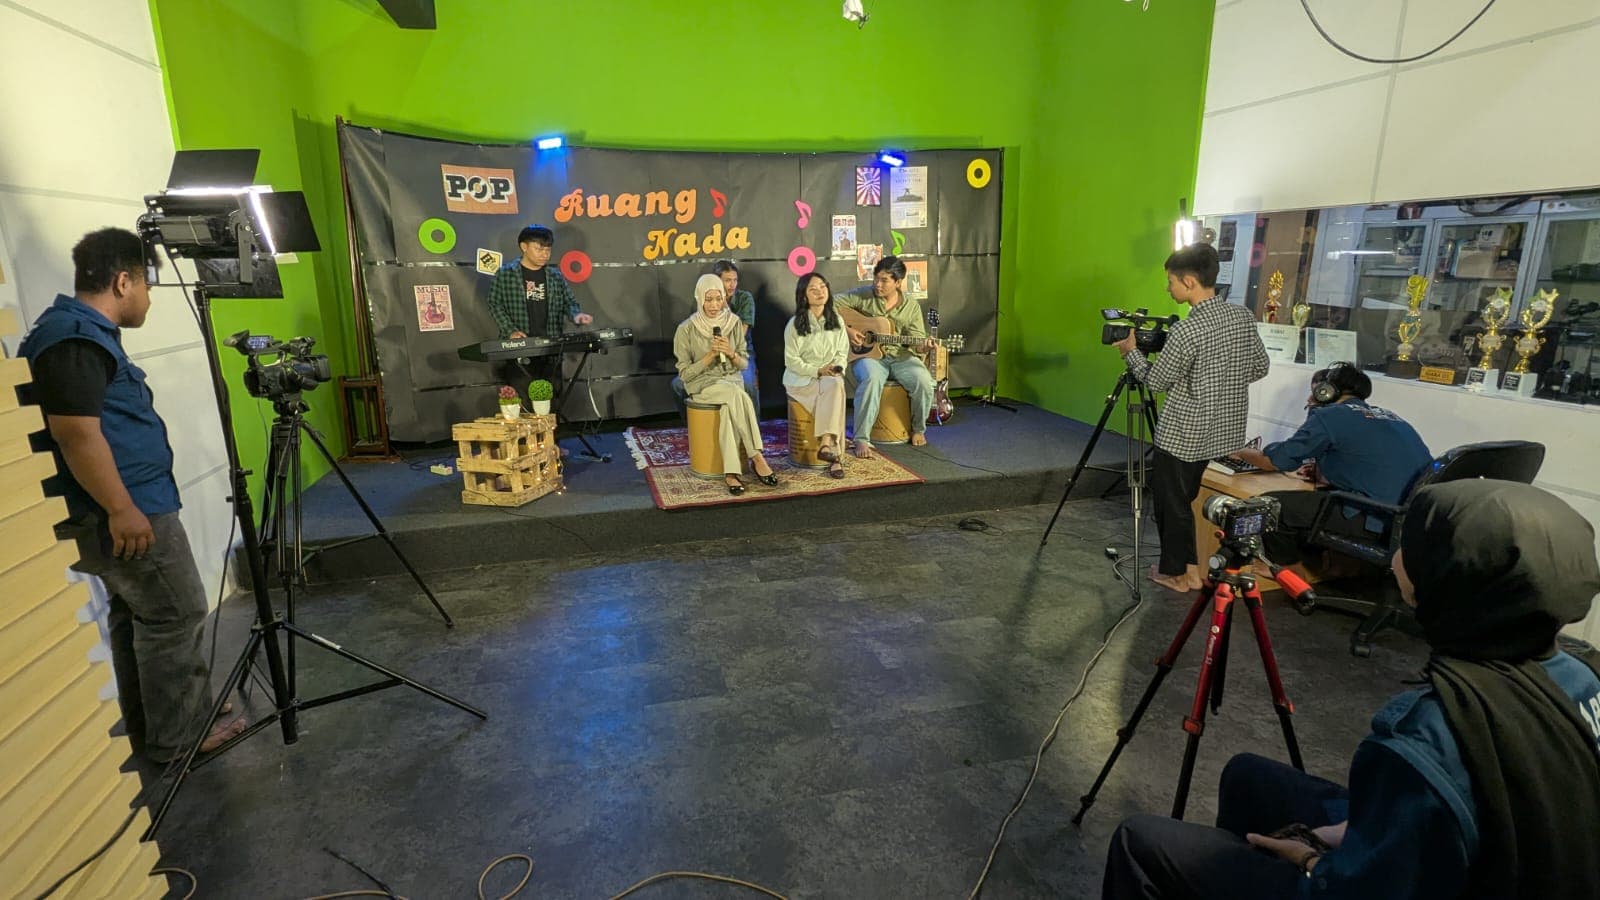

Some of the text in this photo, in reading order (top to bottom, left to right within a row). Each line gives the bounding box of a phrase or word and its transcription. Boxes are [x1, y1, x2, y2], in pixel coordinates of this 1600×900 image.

[444, 173, 512, 204] POP
[553, 188, 697, 225] Ruang
[643, 223, 752, 260] Nada
[416, 286, 448, 294] MUSIC
[501, 340, 526, 350] Roland
